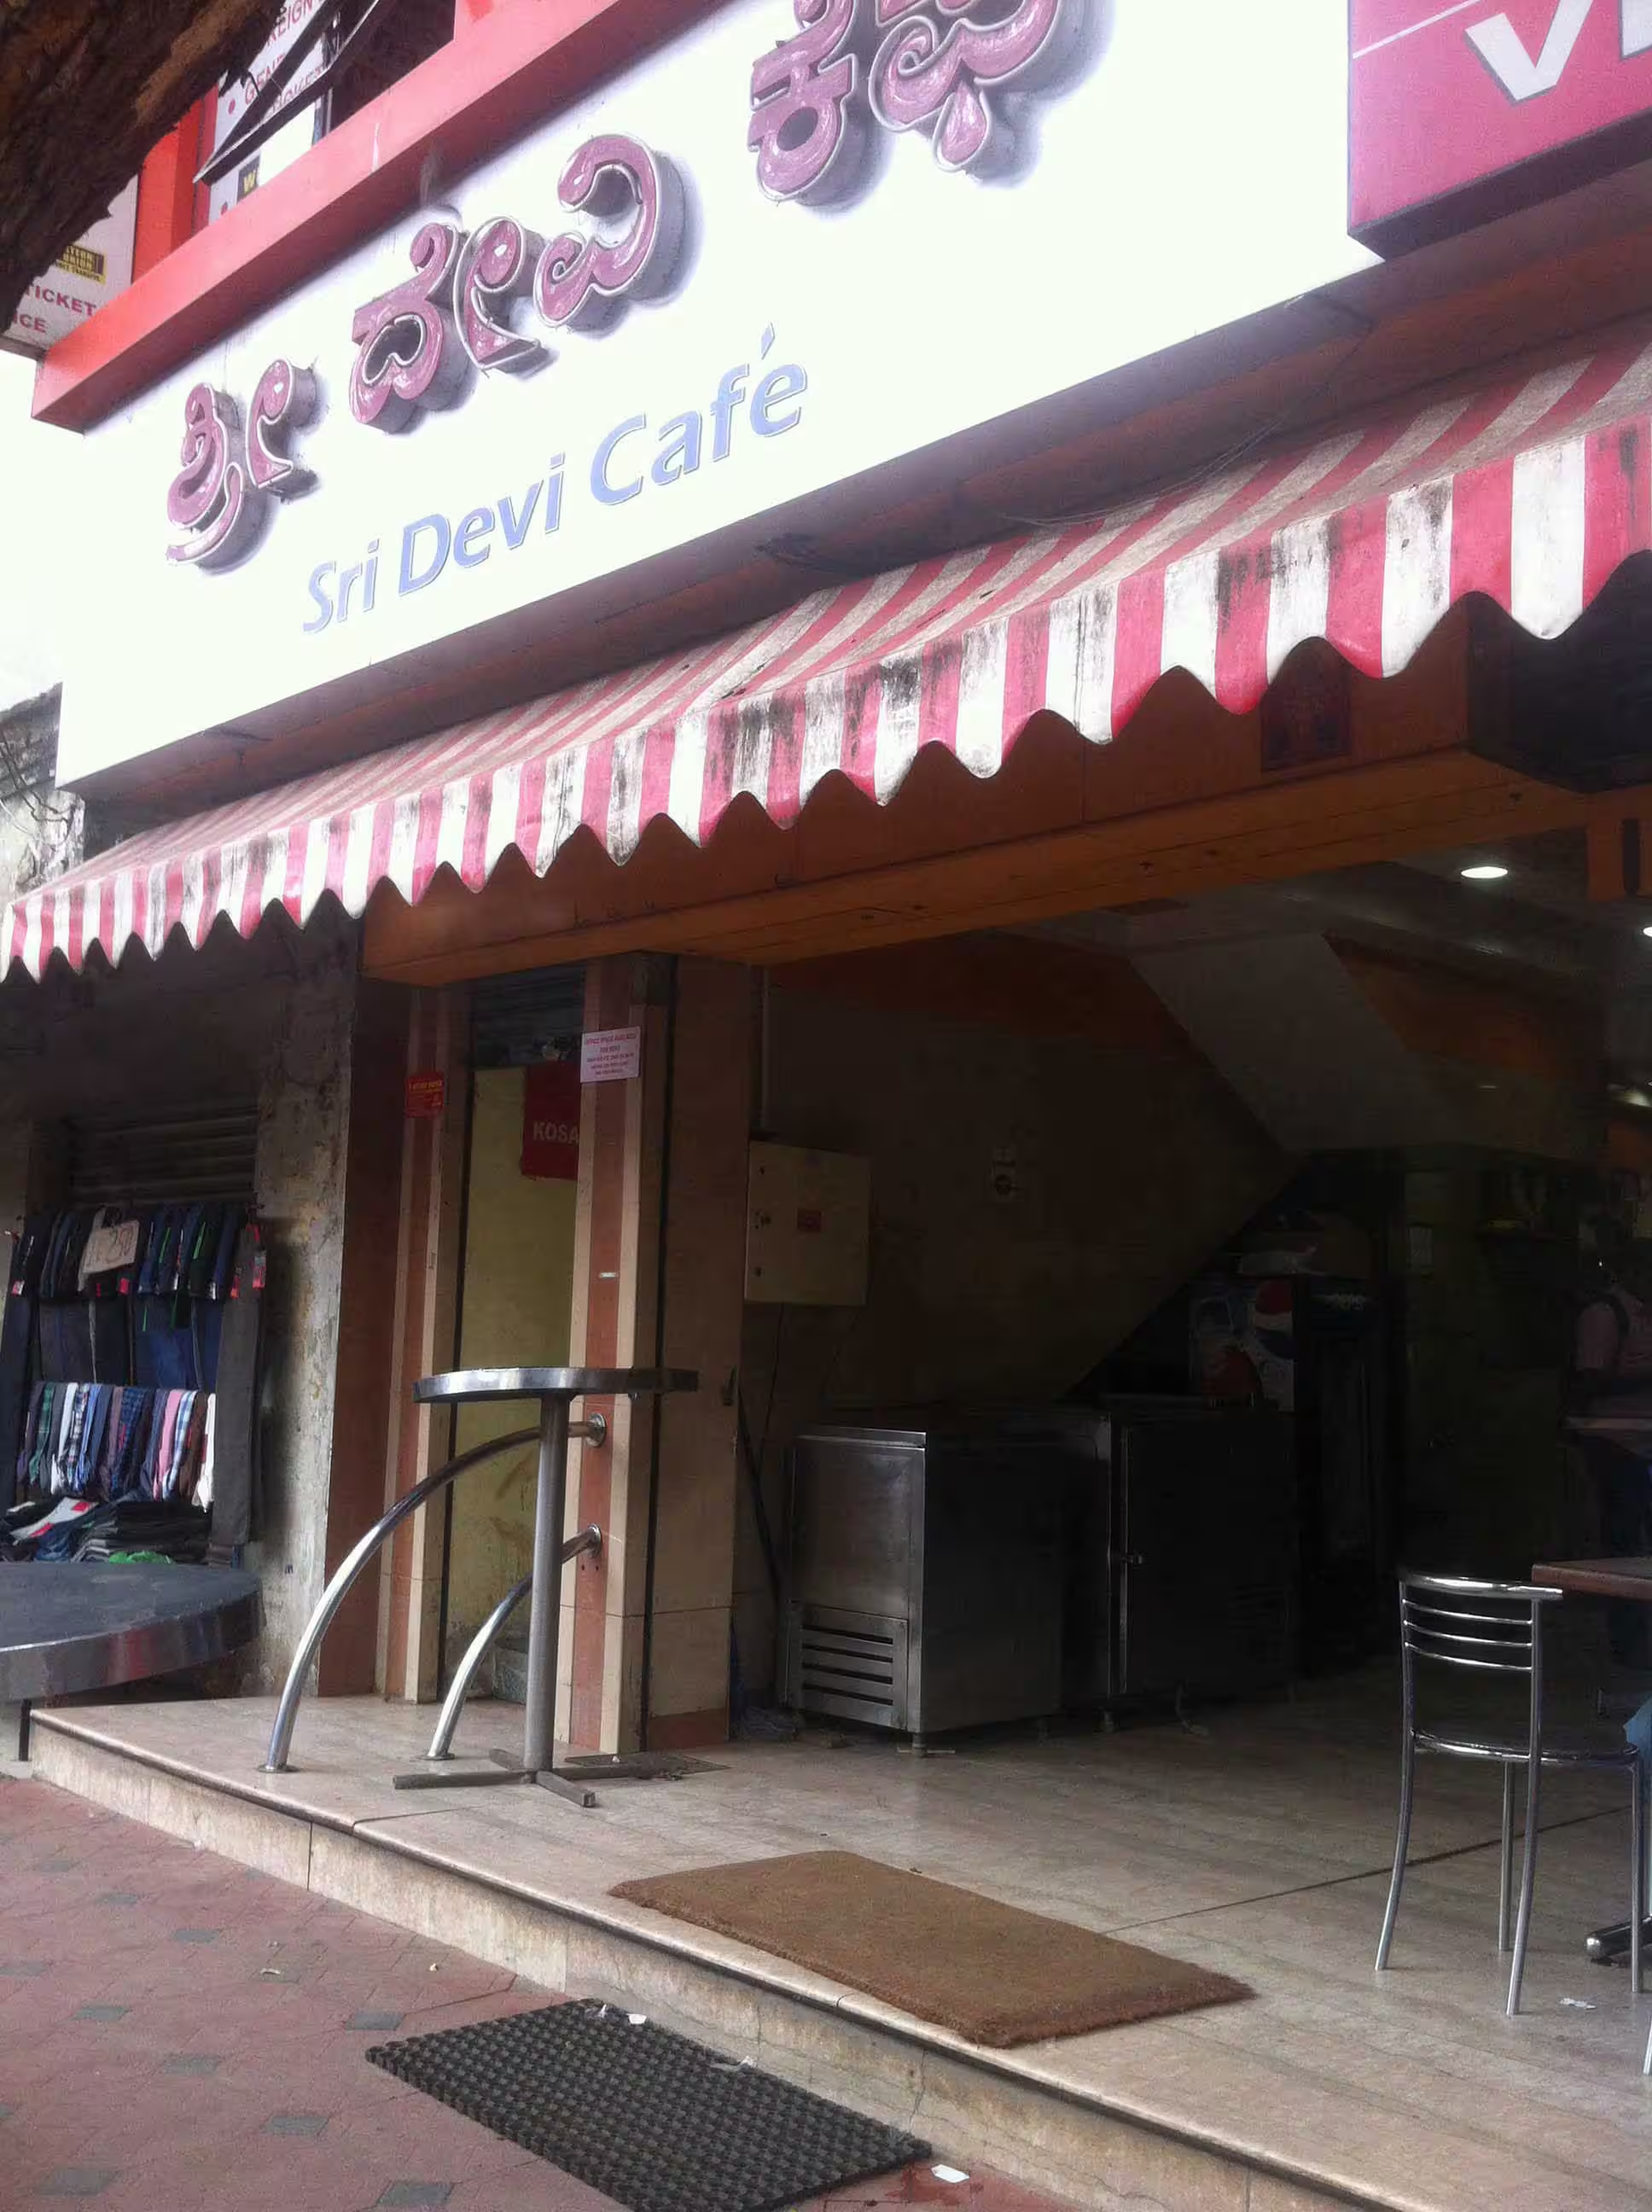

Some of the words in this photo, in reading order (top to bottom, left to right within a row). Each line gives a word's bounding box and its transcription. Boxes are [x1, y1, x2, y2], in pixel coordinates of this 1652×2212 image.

[303, 538, 381, 634] Sri
[398, 451, 566, 596] Devi
[590, 322, 808, 505] Café
